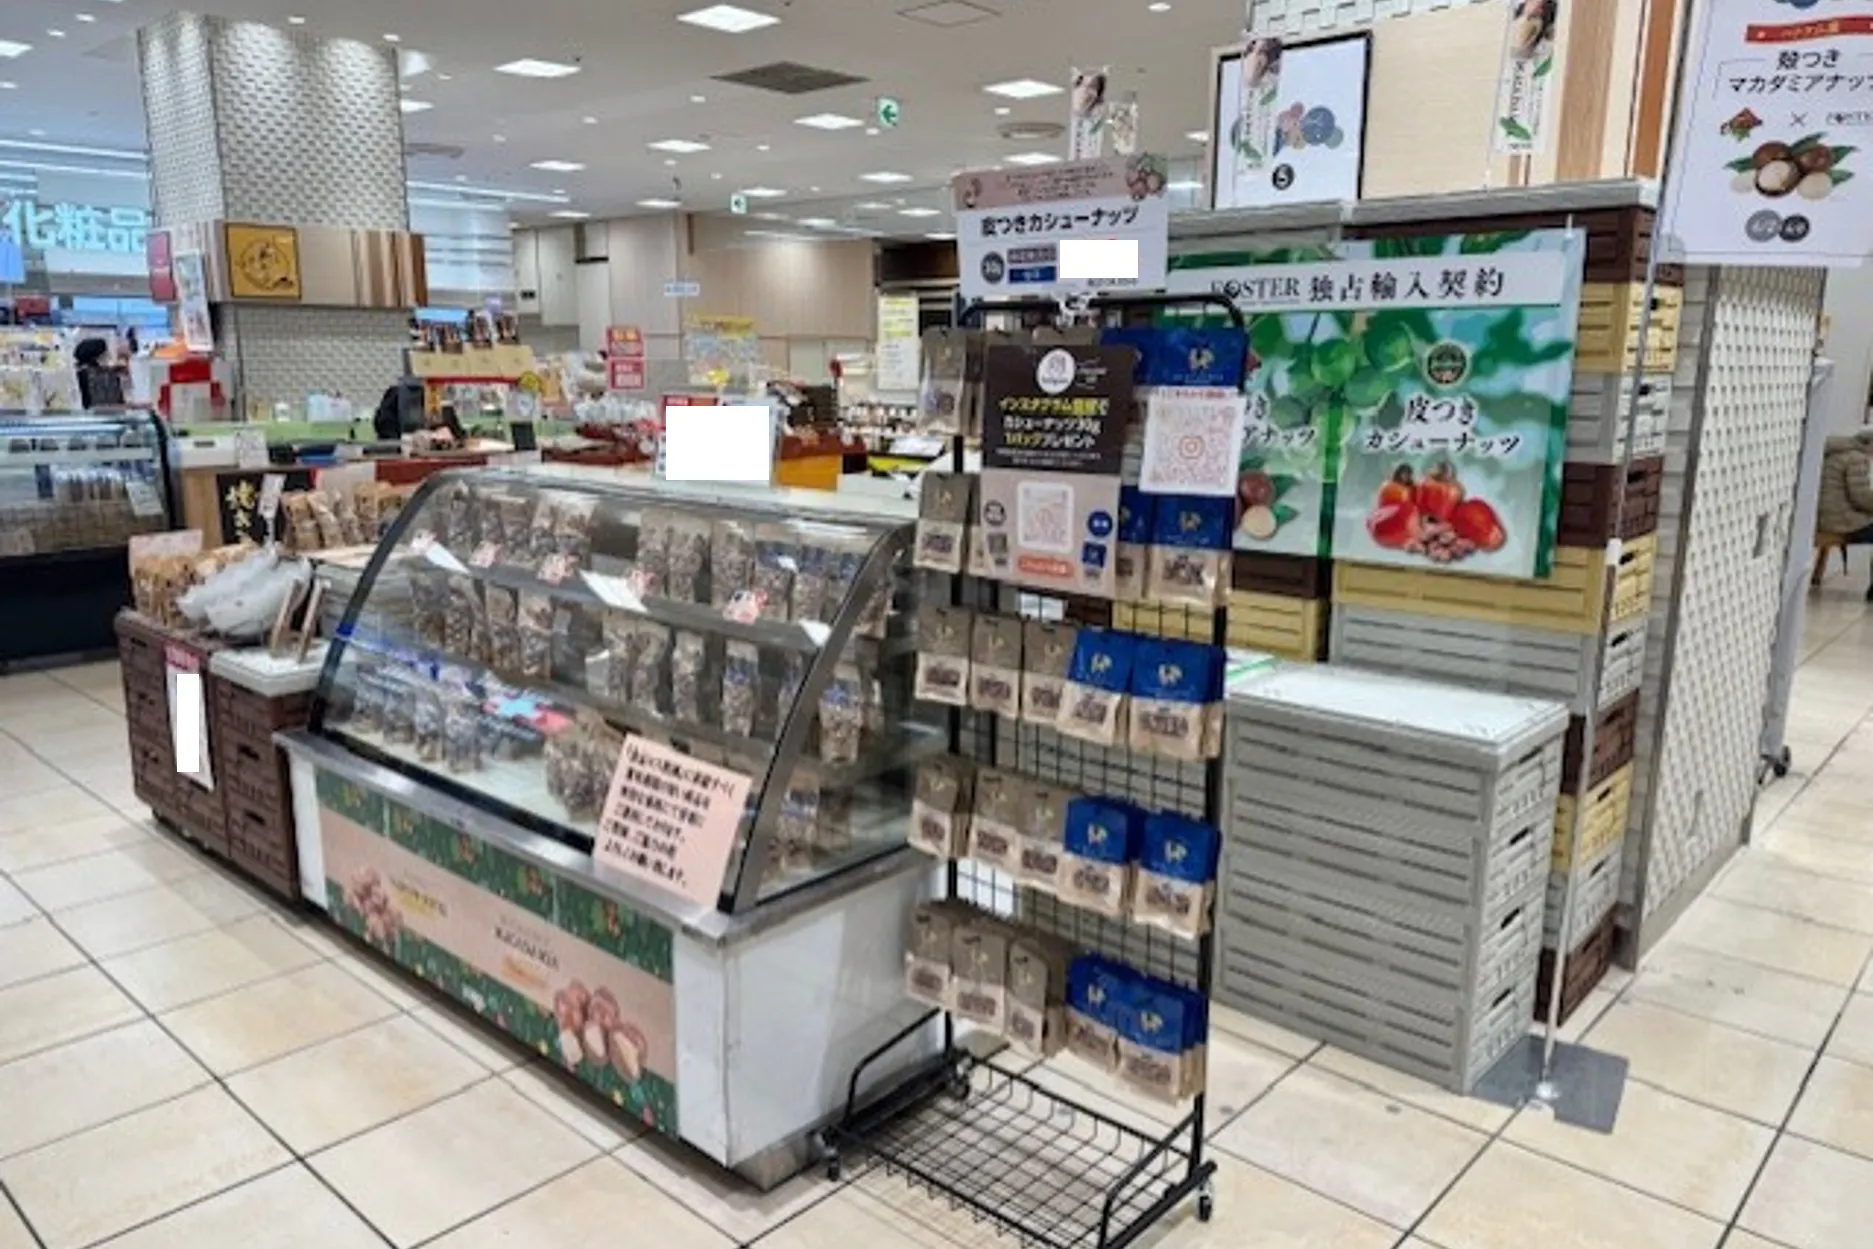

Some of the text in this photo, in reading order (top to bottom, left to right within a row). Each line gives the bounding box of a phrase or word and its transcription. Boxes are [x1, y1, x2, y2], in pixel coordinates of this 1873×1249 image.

[1777, 49, 1840, 70] 殻つき
[2, 199, 149, 253] 化粧品
[981, 206, 1139, 237] 皮つきカシューナッツ
[1309, 266, 1505, 303] 独占輸入契約
[1405, 395, 1474, 425] 皮つき
[1366, 429, 1521, 454] カシューナッツ
